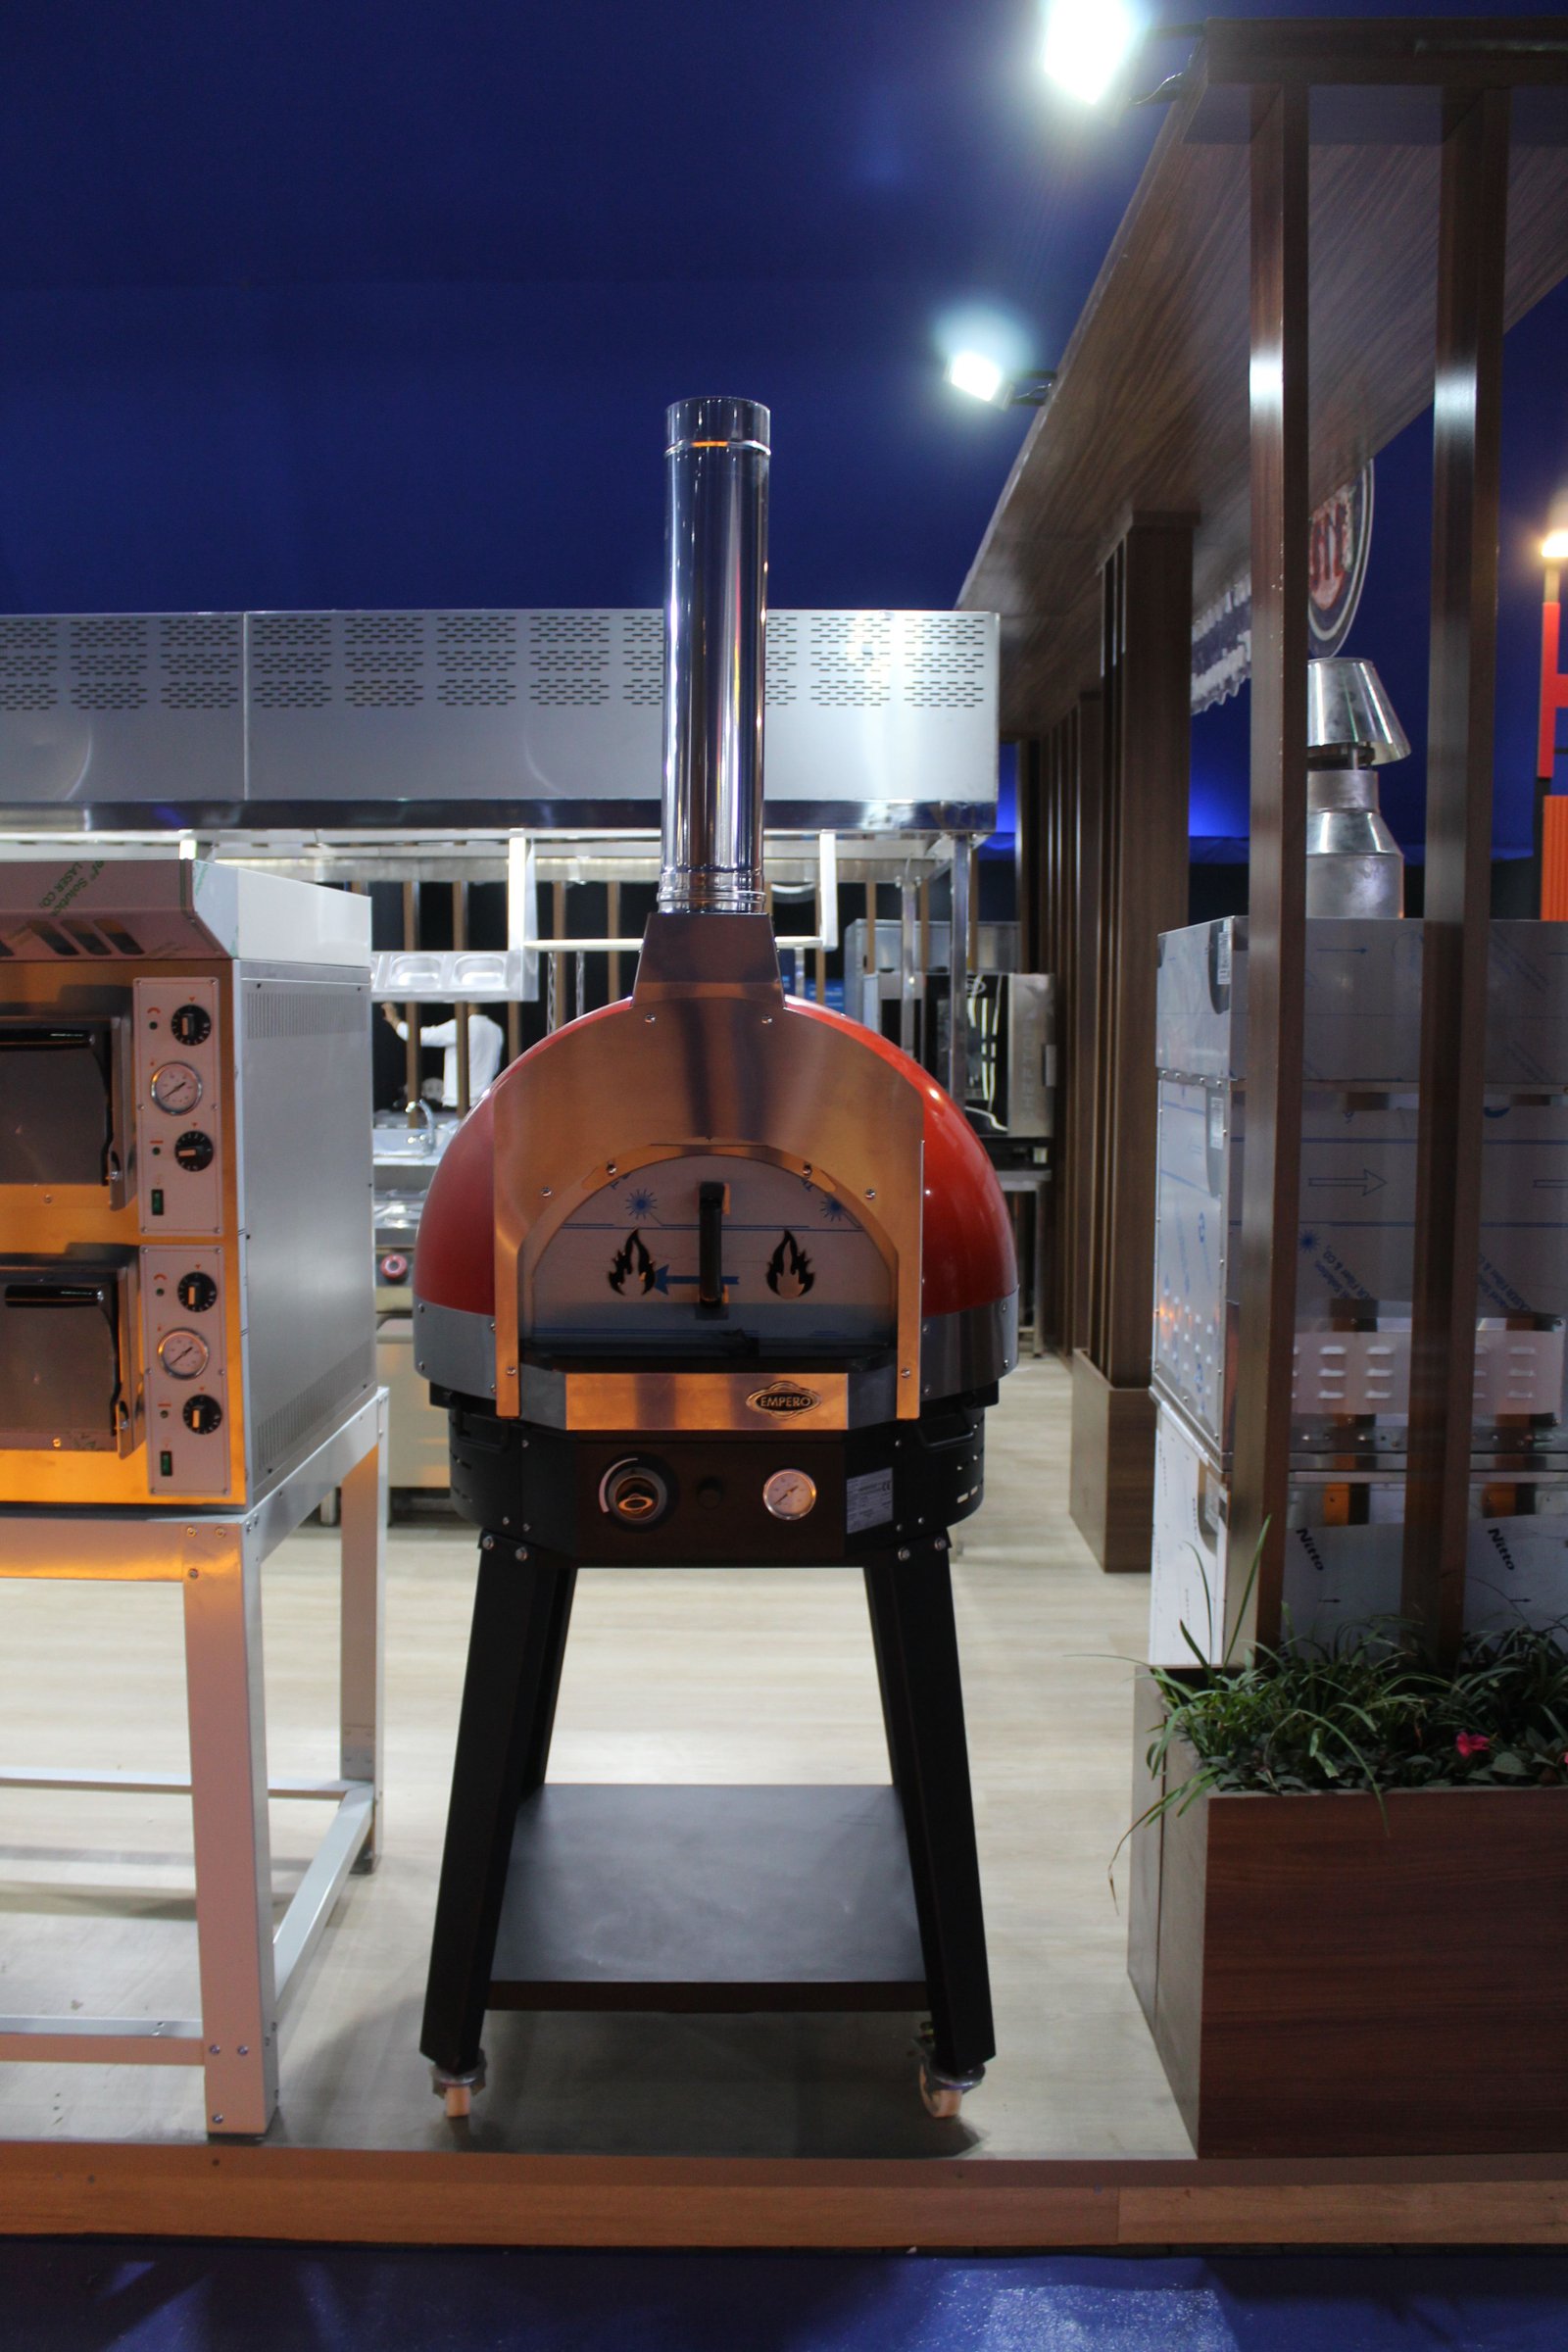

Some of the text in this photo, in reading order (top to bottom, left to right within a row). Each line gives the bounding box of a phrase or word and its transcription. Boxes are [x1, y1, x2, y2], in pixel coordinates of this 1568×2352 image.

[760, 1396, 811, 1407] EMPERO
[1295, 1528, 1325, 1571] Nitto
[1488, 1528, 1515, 1571] Nitto
